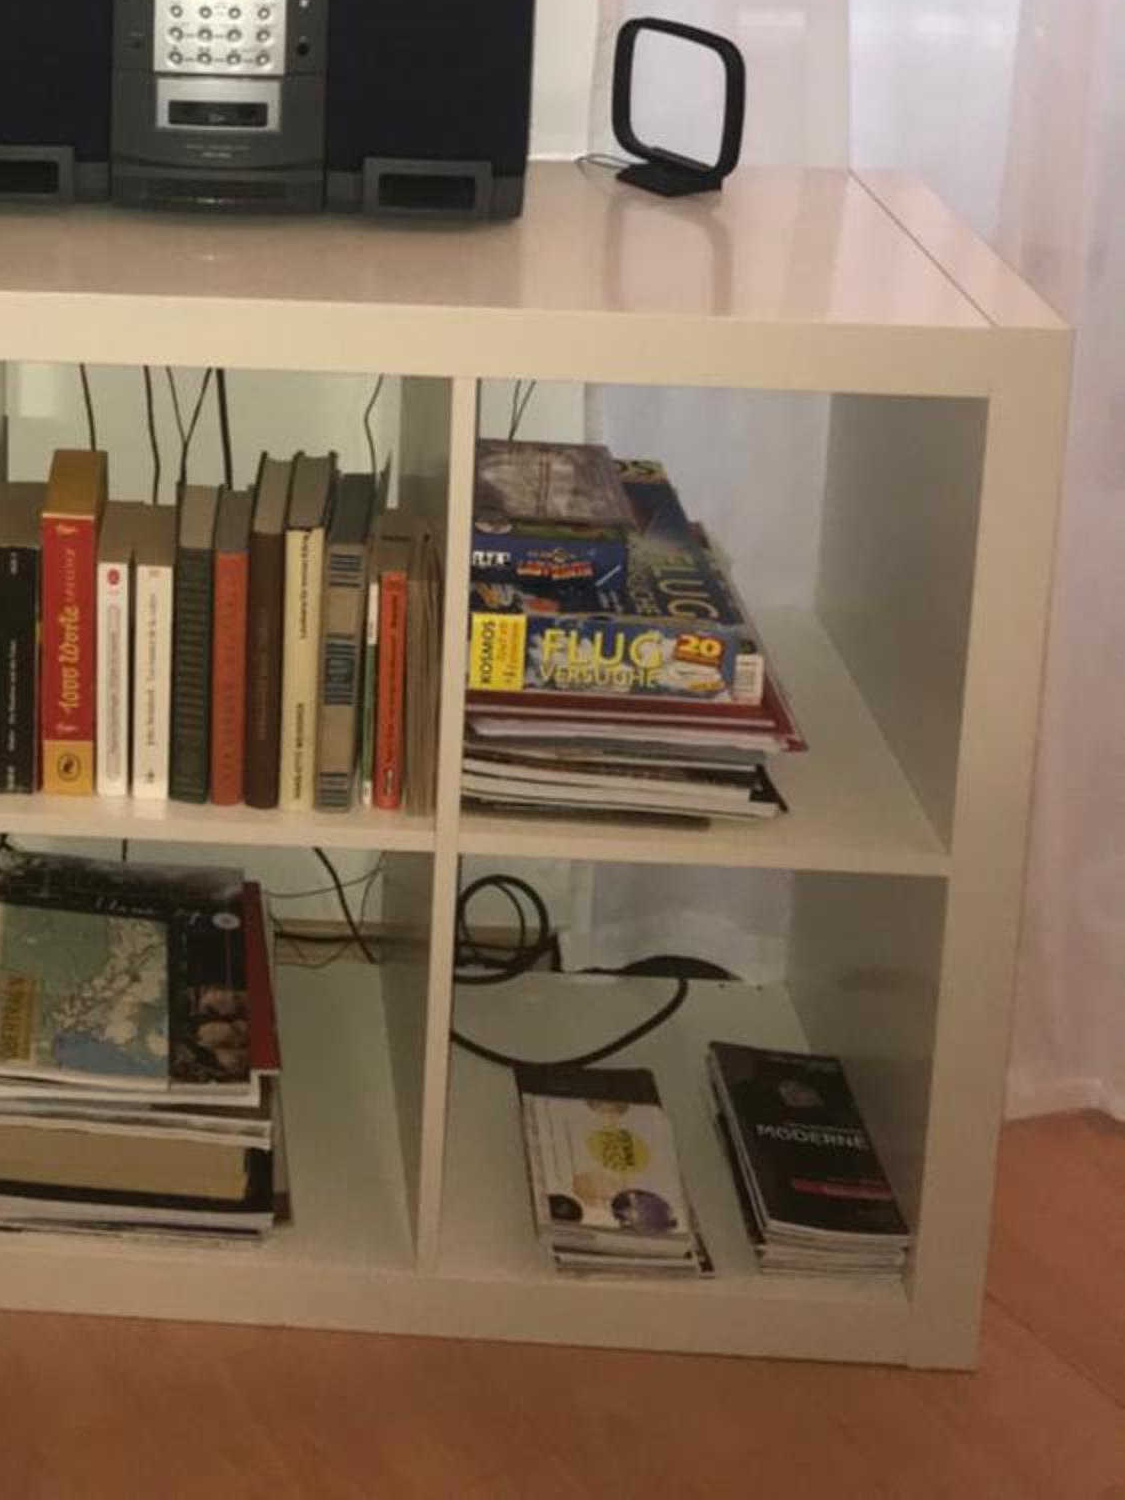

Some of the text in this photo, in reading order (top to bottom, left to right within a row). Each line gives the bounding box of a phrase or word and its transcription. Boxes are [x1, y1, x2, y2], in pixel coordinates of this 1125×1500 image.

[480, 620, 497, 684] KOSMOS
[541, 628, 665, 669] FLUG
[676, 634, 722, 657] 20
[540, 665, 661, 689] VERSUCHE
[755, 1122, 868, 1152] MODERNE
